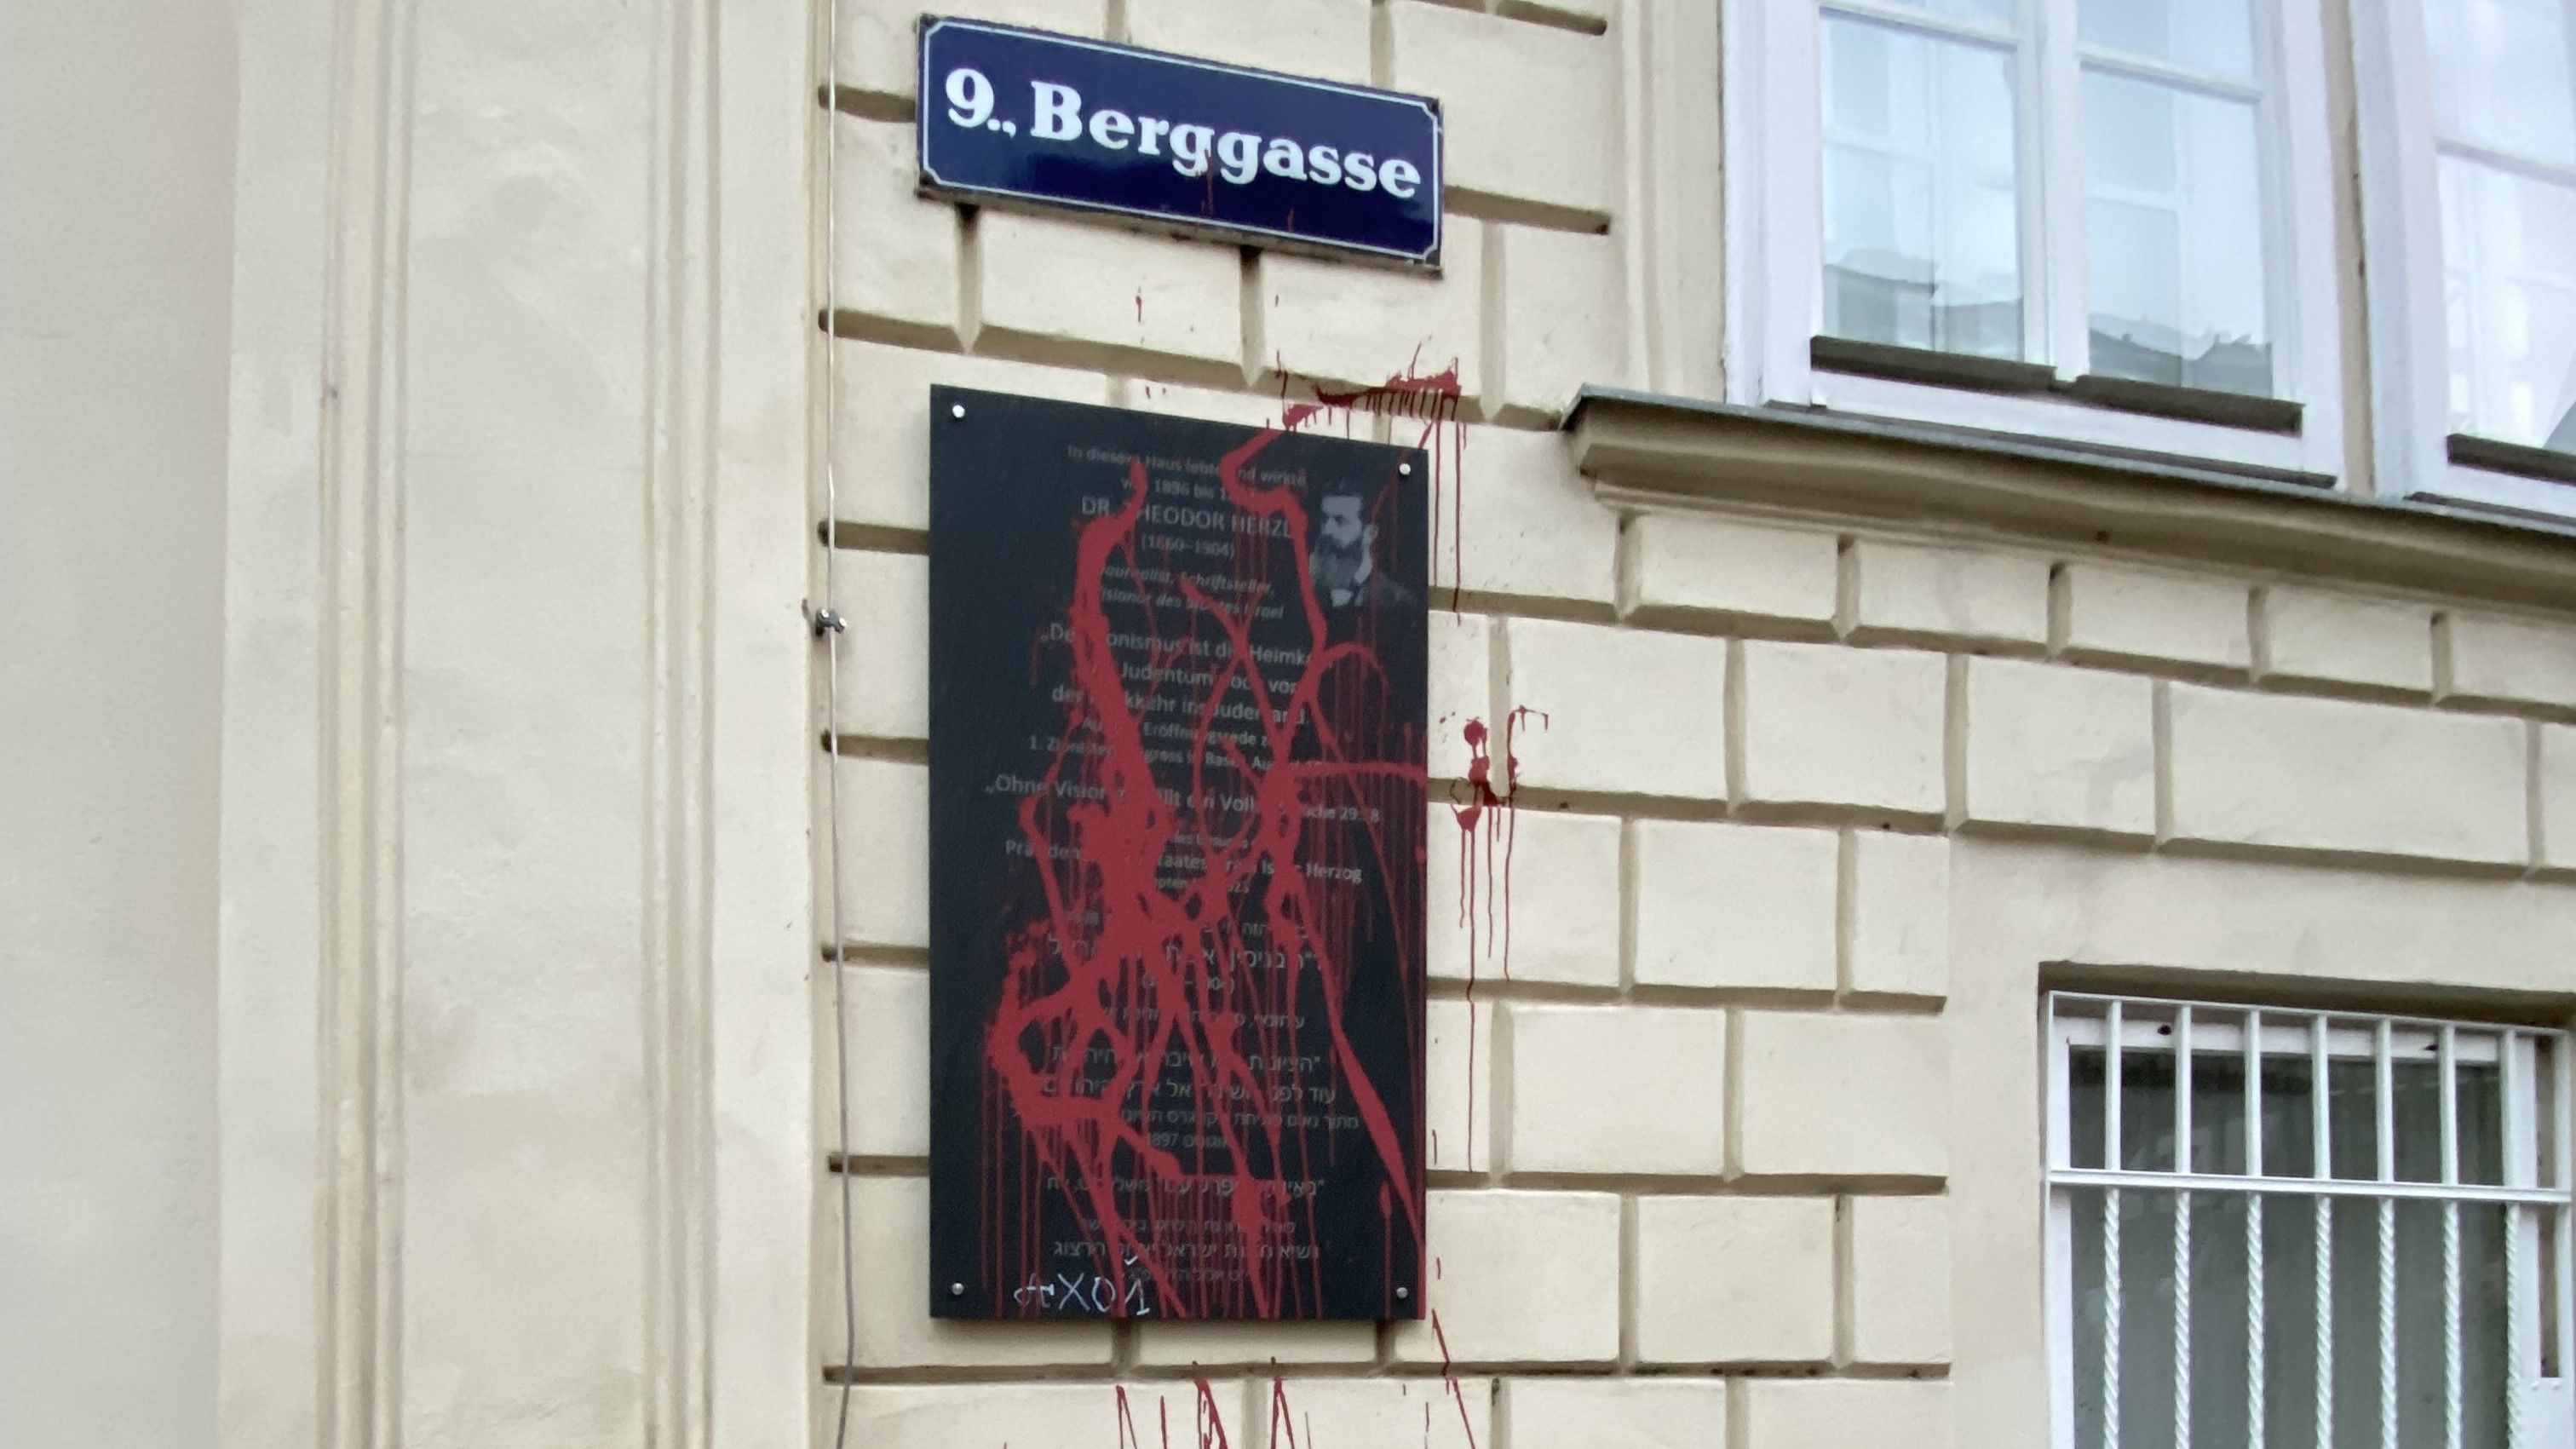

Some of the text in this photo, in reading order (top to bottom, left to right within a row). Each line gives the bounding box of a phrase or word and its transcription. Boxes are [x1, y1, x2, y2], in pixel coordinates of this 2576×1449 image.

[945, 67, 1423, 199] 9., Berggasse
[1145, 455, 1182, 472] Haus
[1123, 501, 1225, 532] HEODOR
[1230, 514, 1292, 539] HERZL
[1156, 591, 1182, 608] des
[1039, 622, 1083, 644] „De
[1090, 628, 1184, 653] onismus
[1188, 637, 1210, 658] ist
[1214, 639, 1239, 659] di
[1122, 661, 1214, 687] Judentum
[1306, 862, 1363, 884] Herzog
